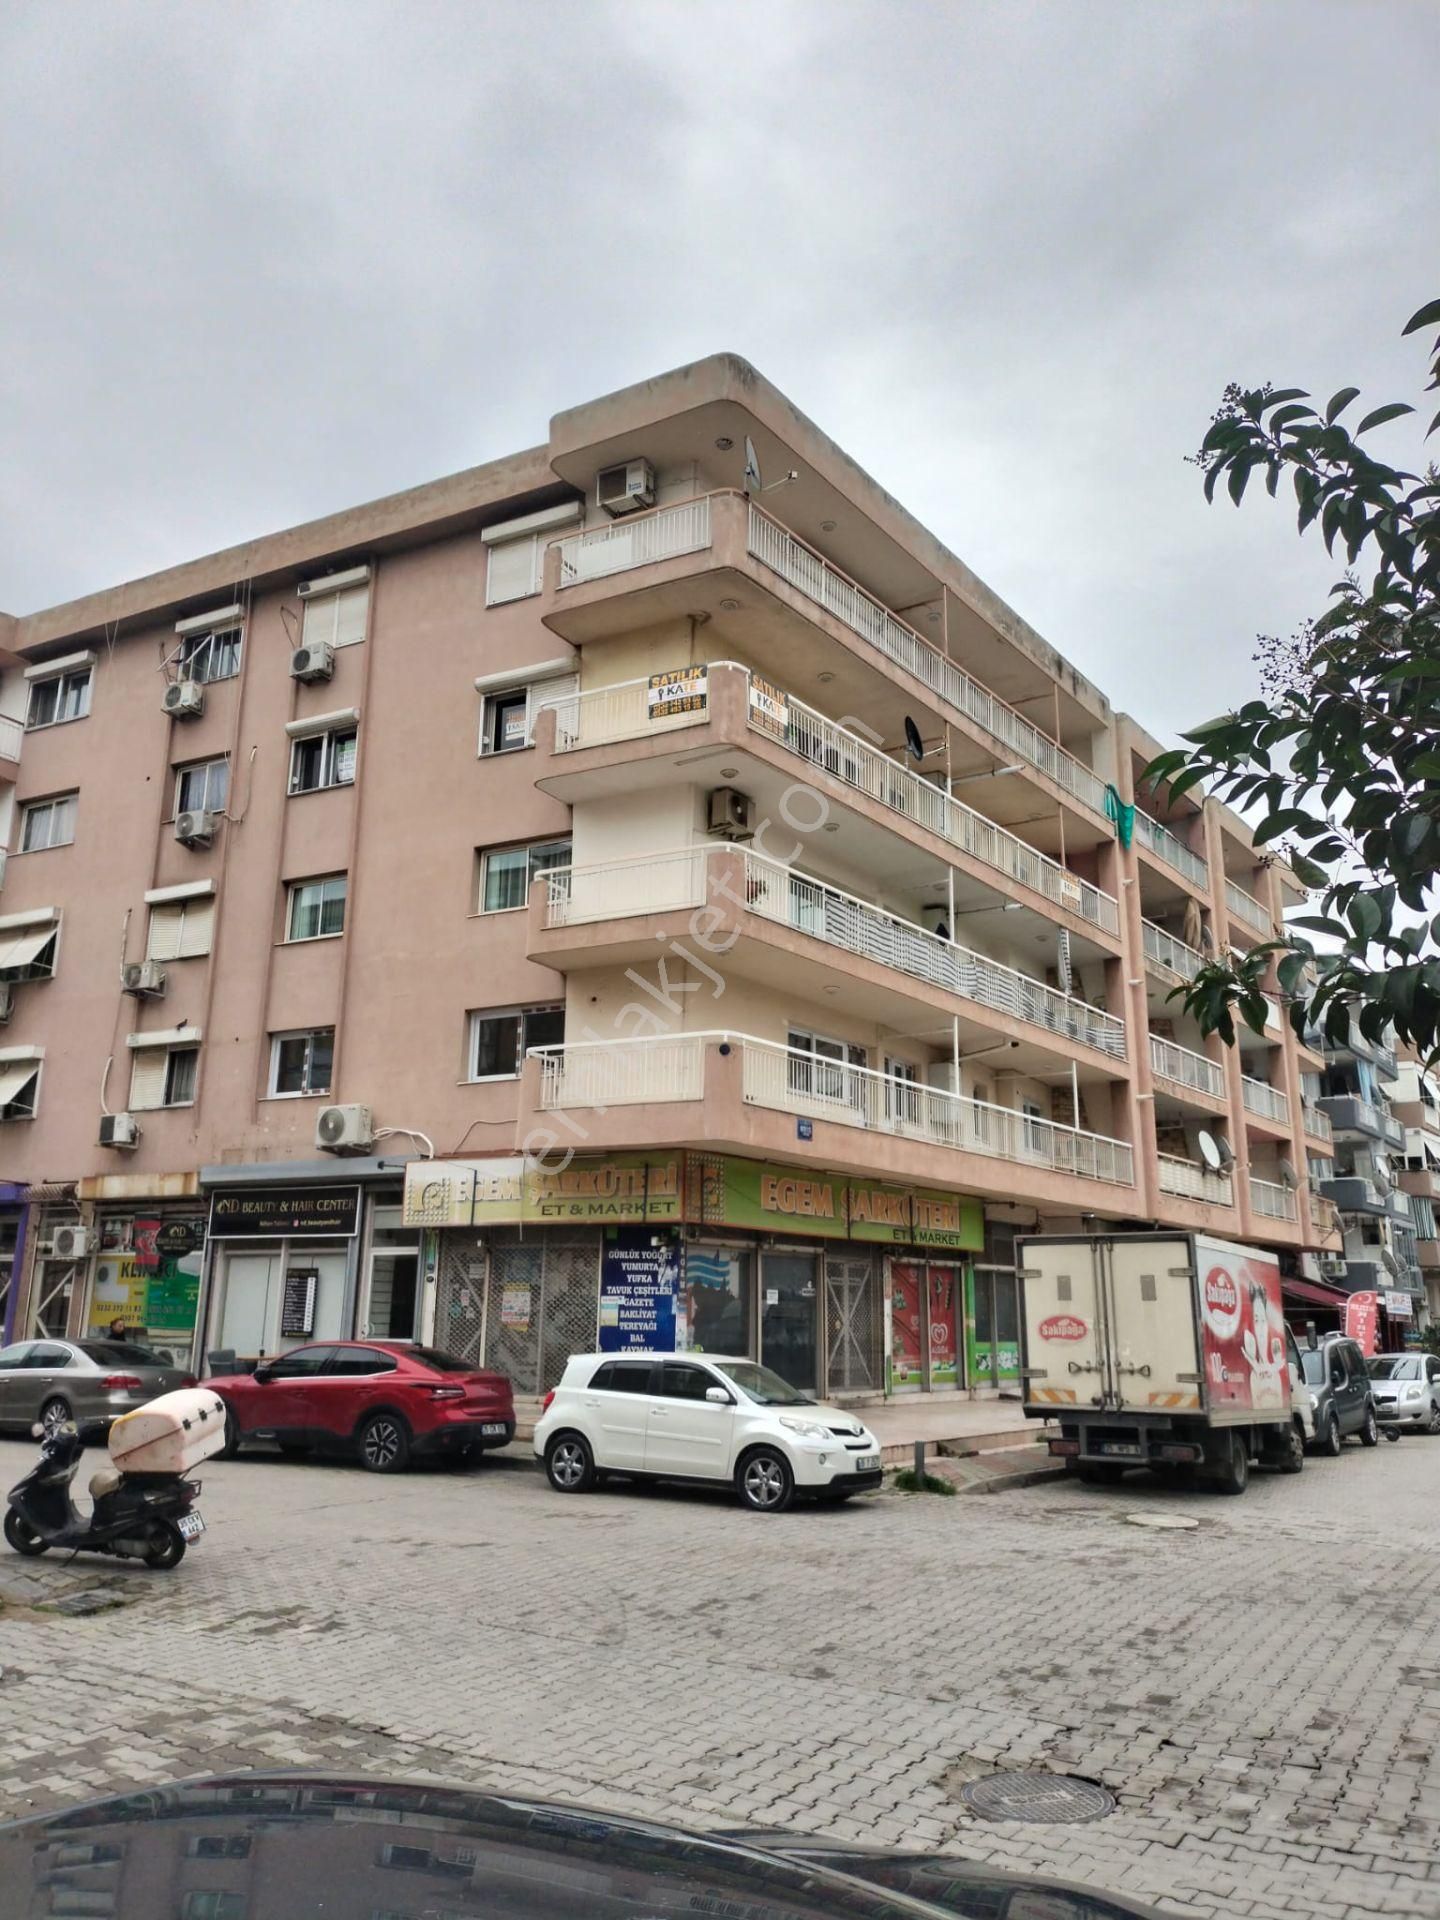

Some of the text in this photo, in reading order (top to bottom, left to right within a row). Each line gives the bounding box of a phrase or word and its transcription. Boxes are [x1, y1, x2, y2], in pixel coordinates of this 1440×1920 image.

[651, 667, 704, 688] SATILIK
[753, 674, 785, 707] SATILIK
[760, 1174, 835, 1218] EGEM
[242, 1201, 276, 1213] BEAUTY
[279, 1201, 289, 1212] &
[291, 1200, 314, 1212] HAIR
[316, 1199, 356, 1211] CENTER
[541, 1201, 676, 1216] ET & MARKET
[892, 1229, 906, 1240] ET
[919, 1231, 961, 1246] MARKET
[608, 1248, 640, 1260] GÜNLÜK
[621, 1262, 659, 1271] YUMURTA
[626, 1274, 653, 1283] YUFKA
[606, 1286, 632, 1294] TAVUK
[624, 1298, 655, 1307] GAZETE
[620, 1309, 658, 1319] BAKLİYAT
[618, 1320, 657, 1331] TEREYAĞI
[629, 1333, 646, 1343] BAL
